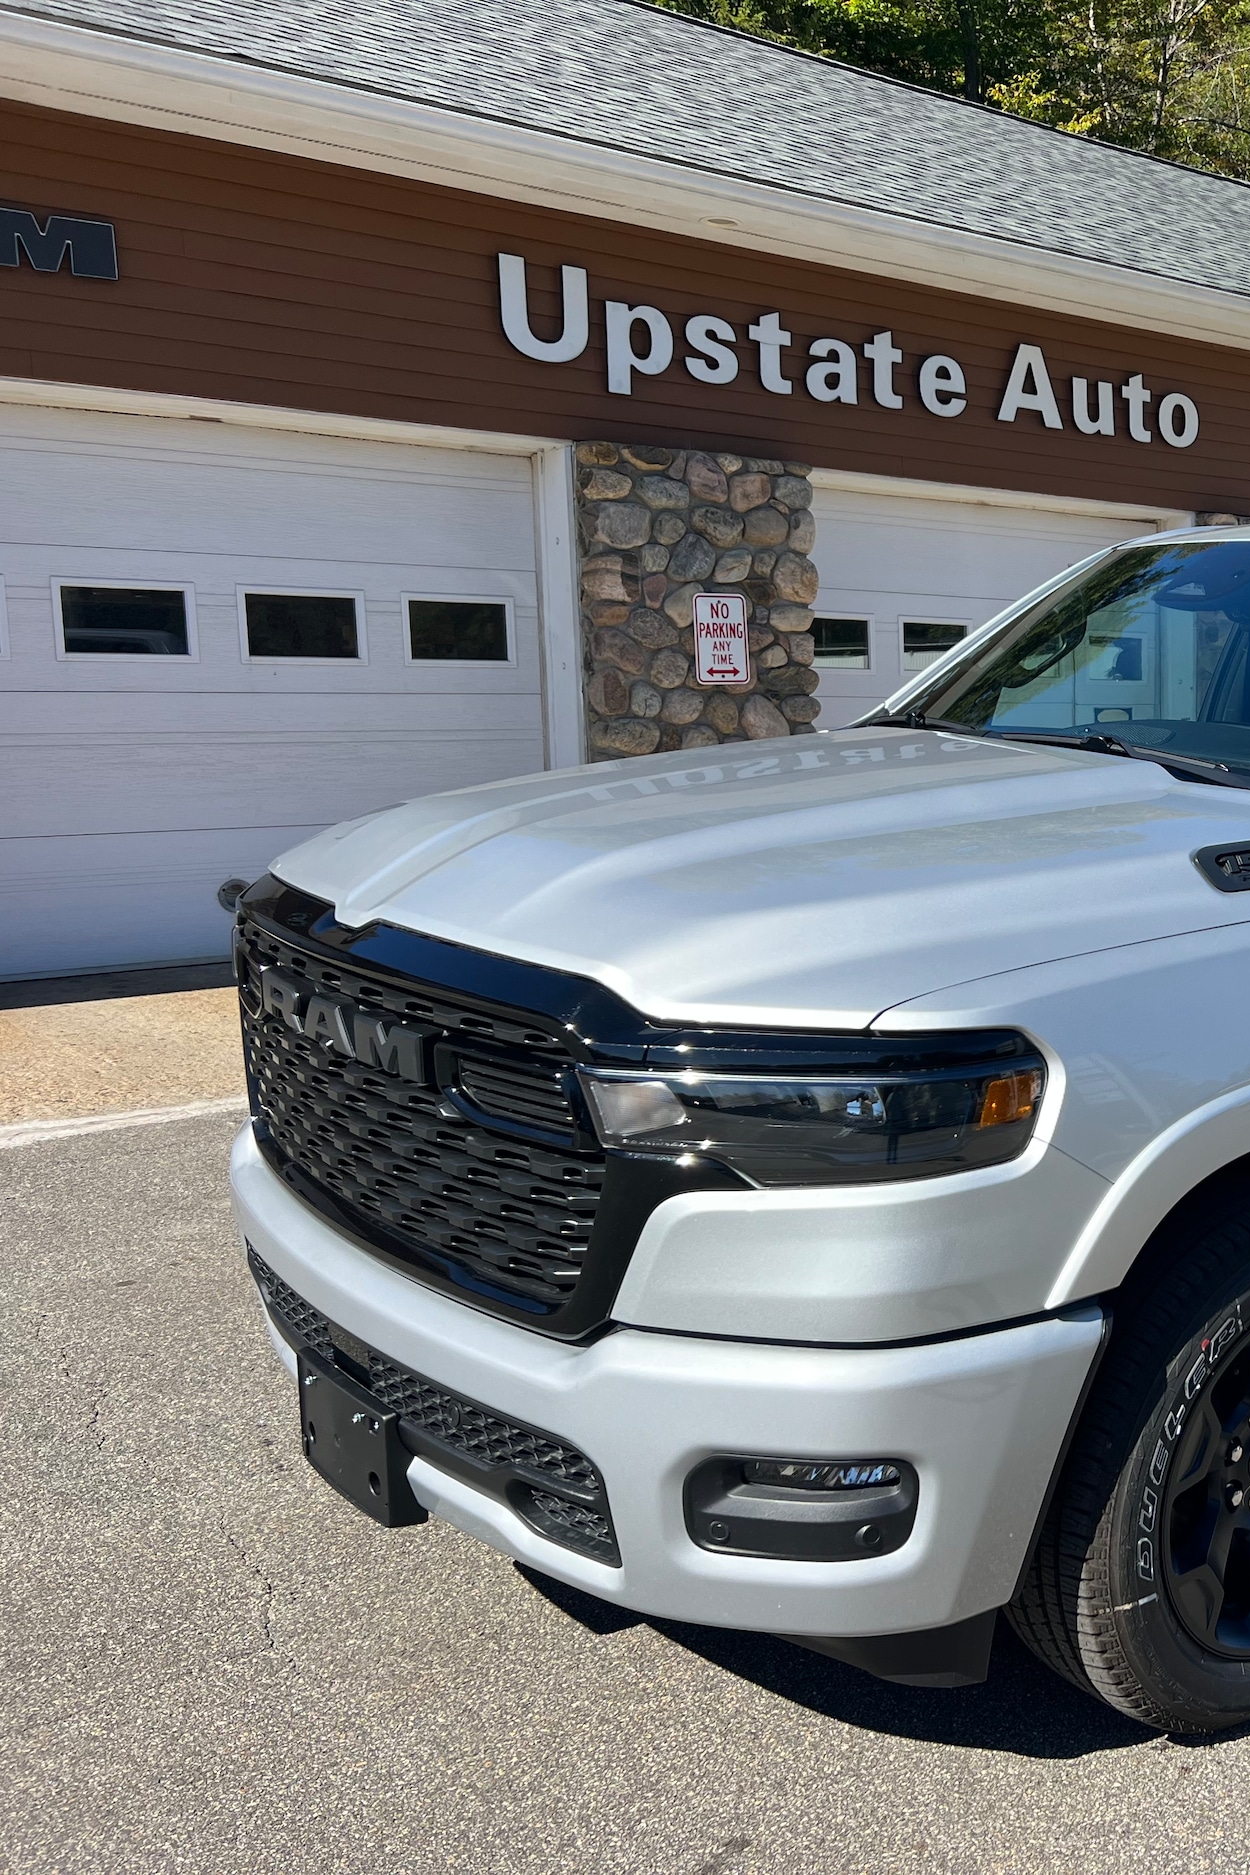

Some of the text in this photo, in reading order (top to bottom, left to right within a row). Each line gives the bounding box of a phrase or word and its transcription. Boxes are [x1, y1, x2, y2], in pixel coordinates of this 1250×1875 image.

[496, 252, 1201, 448] Upstate Auto
[710, 602, 729, 619] NO
[699, 622, 743, 639] PARKING
[713, 641, 731, 652] ANY
[712, 654, 734, 665] TIME
[261, 964, 440, 1085] RAM
[1136, 1316, 1237, 1582] DUELER
